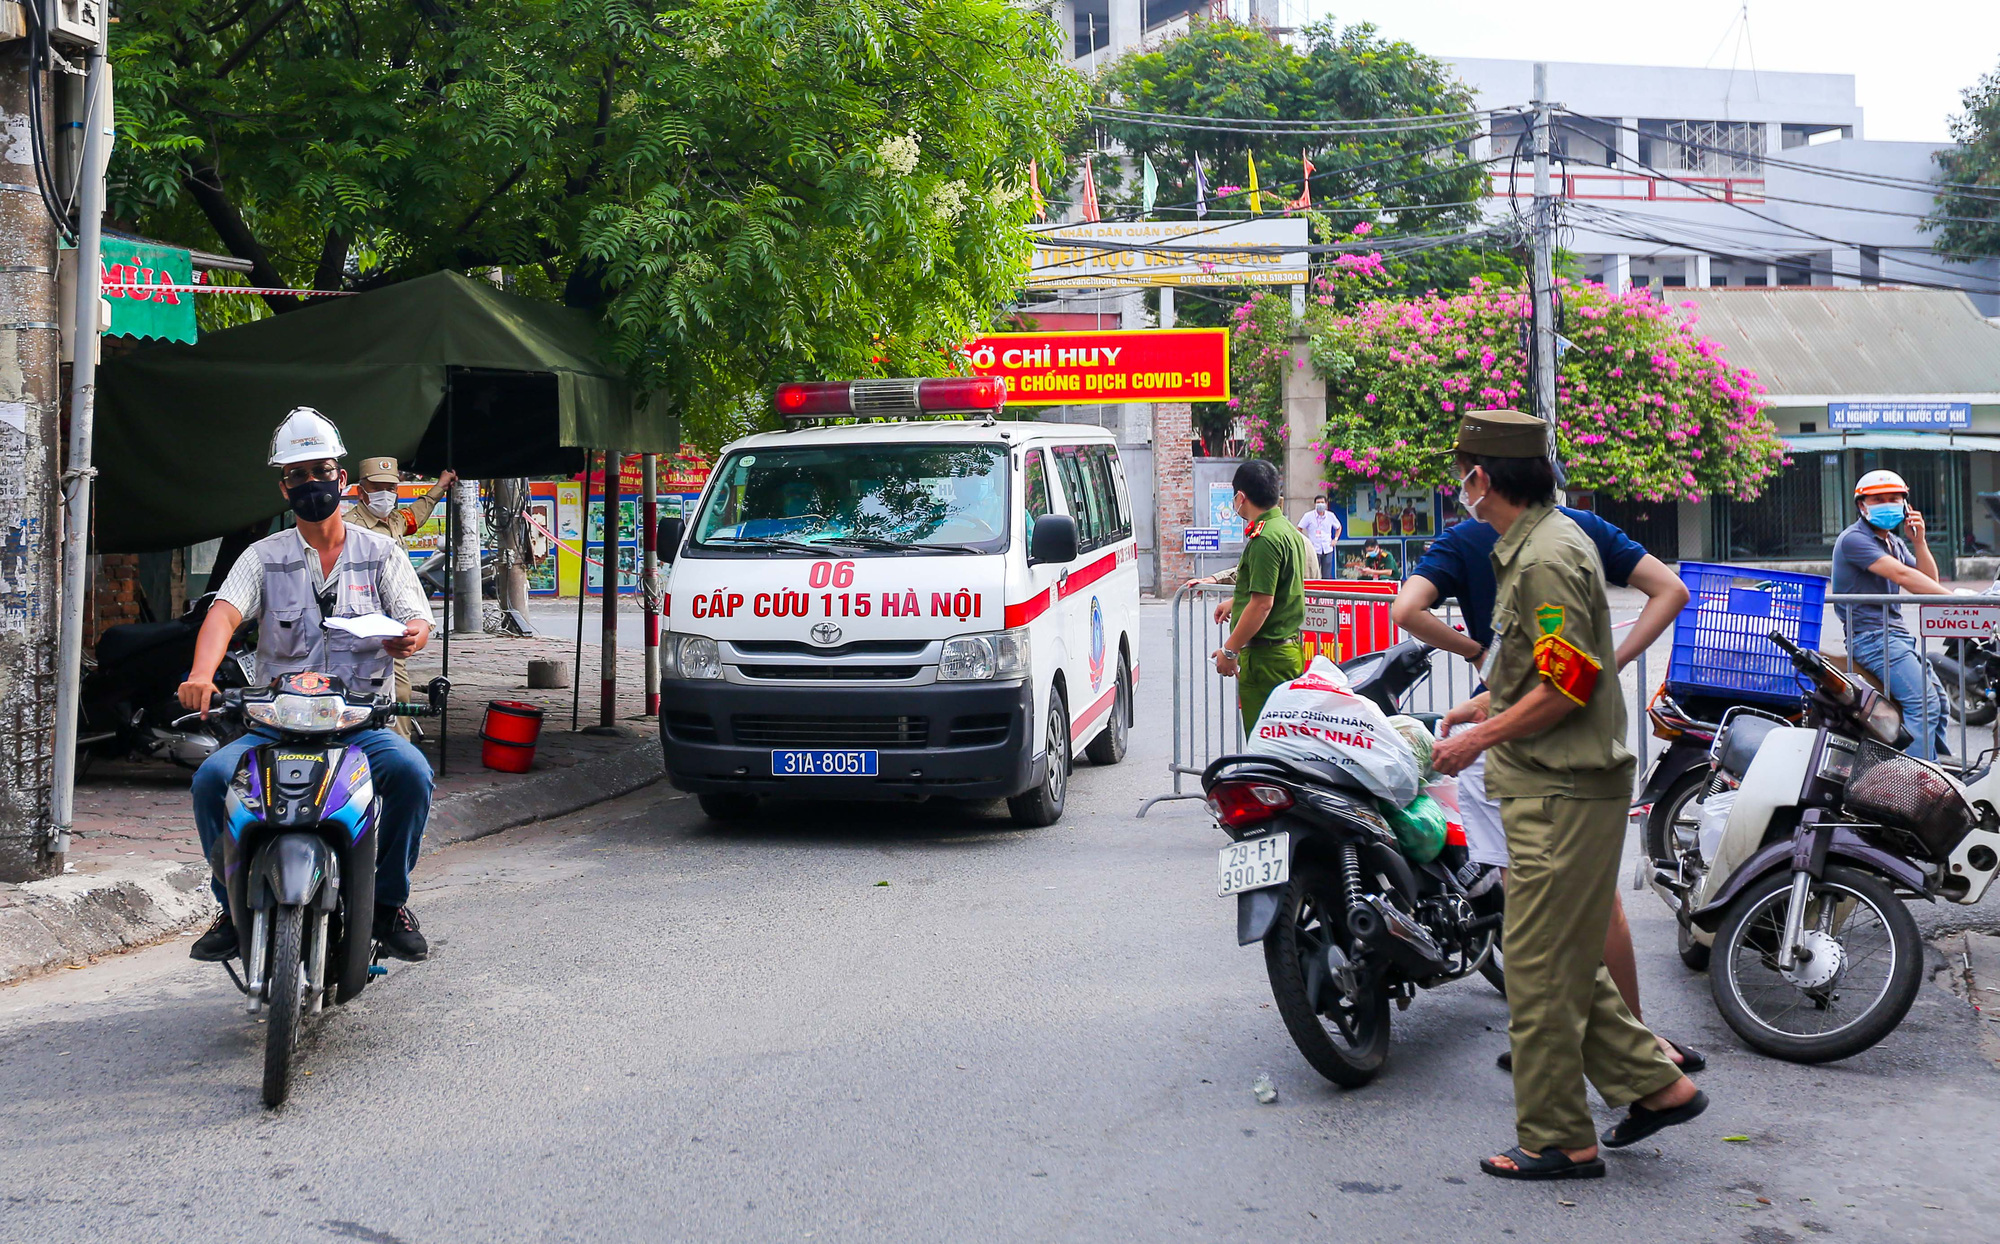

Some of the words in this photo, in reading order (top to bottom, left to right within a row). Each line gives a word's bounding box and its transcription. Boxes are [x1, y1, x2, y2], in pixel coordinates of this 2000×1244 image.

[1060, 227, 1093, 238] NHÂN
[1098, 227, 1122, 237] DÂN
[1127, 226, 1163, 238] QUẬN
[1165, 224, 1198, 236] ĐỐNG
[1092, 249, 1134, 270] HỌC
[1002, 344, 1051, 369] CHỈ
[1058, 347, 1122, 368] HUY
[1021, 370, 1080, 392] CHỐNG
[1085, 373, 1126, 394] DỊCH
[1847, 409, 1880, 424] NGHIỆP
[1883, 409, 1904, 424] ĐIỆN
[1906, 407, 1932, 422] NƯỚC
[1934, 409, 1948, 422] CƠ
[1950, 408, 1966, 422] KHÍ
[809, 561, 855, 588] 06
[692, 587, 744, 618] CẤP
[754, 587, 809, 617] CỨU
[821, 593, 871, 617] 115
[881, 588, 920, 617] HÀ
[931, 588, 981, 622] NỘI
[1305, 617, 1328, 627] STOP
[1926, 616, 1968, 629] DỪNG
[1261, 711, 1298, 720] LAPTOP
[1300, 710, 1338, 724] CHÍNH
[1260, 722, 1288, 739] GIÁ
[1289, 720, 1321, 738] TỐT
[1325, 729, 1375, 750] NHẤT
[277, 754, 325, 763] HONDA
[784, 752, 866, 773] 31A-8051
[1229, 838, 1276, 868] 29-F1
[1223, 859, 1283, 891] 390.37
